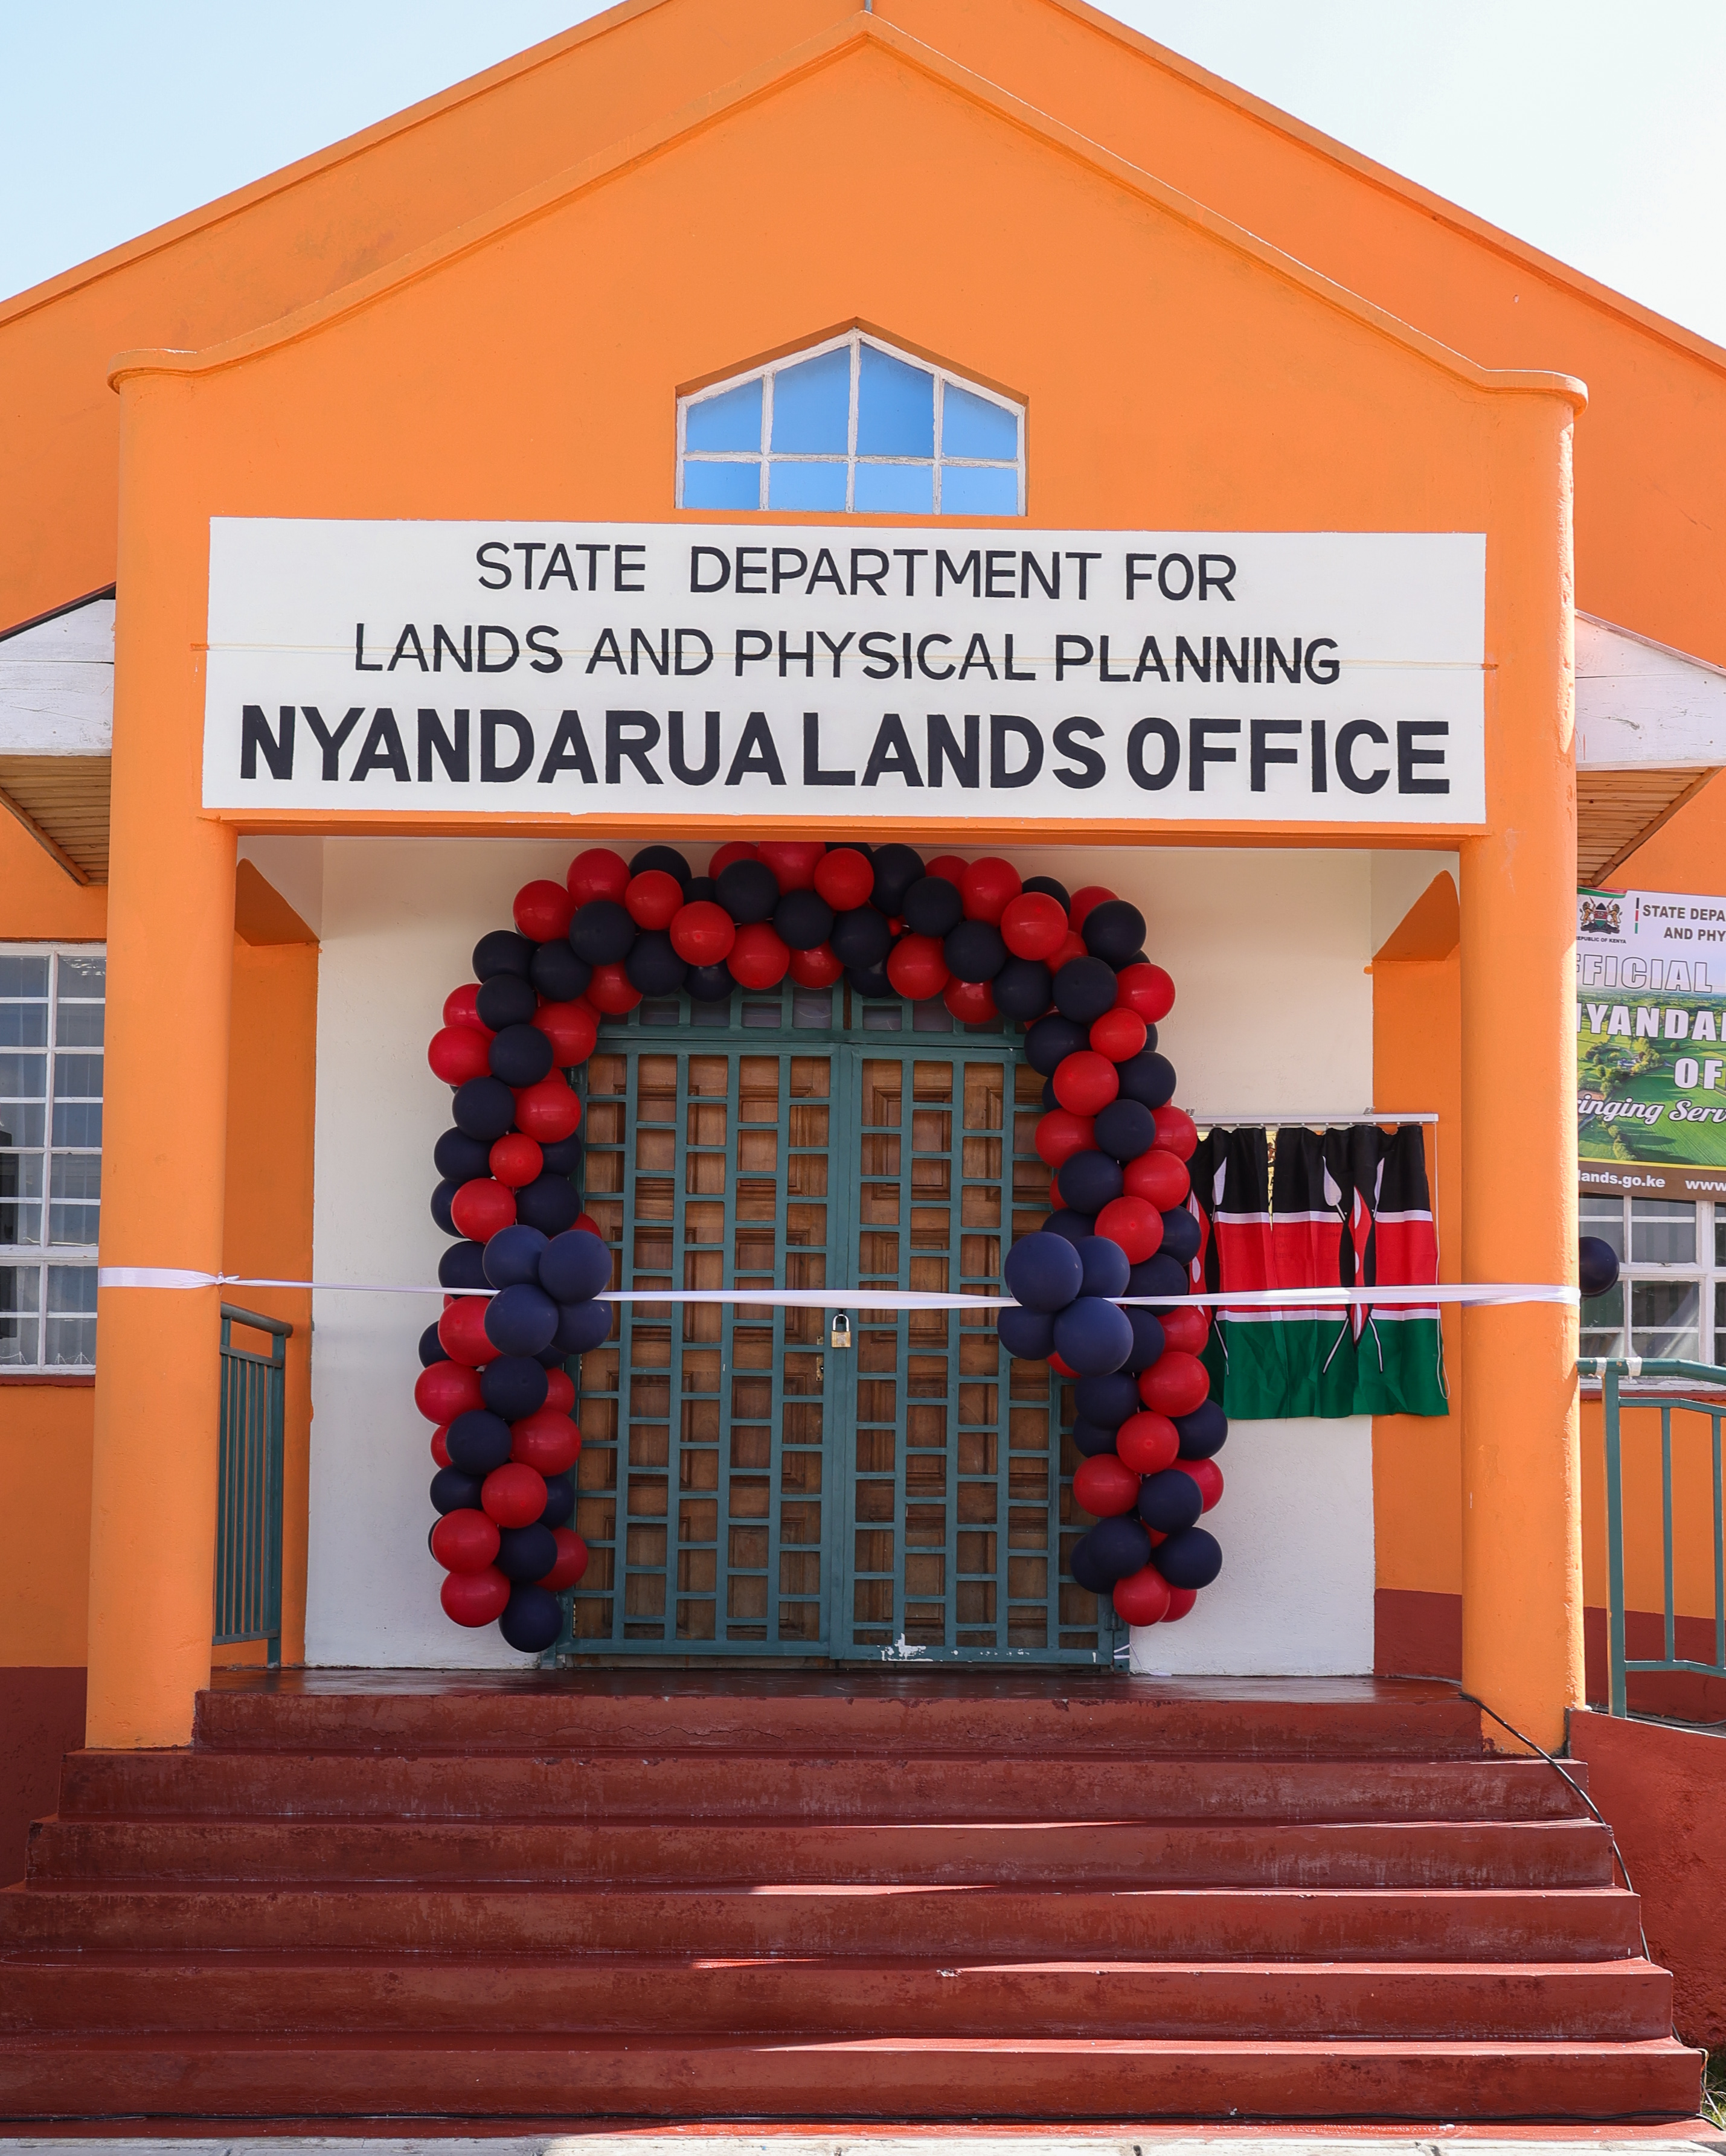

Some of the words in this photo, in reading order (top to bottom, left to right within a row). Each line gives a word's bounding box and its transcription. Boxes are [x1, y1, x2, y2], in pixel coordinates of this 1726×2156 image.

[476, 542, 646, 592] STATE
[690, 546, 1102, 600] DEPARTMENT
[1126, 553, 1236, 601] FOR
[355, 623, 563, 674] LANDS
[585, 628, 714, 676] AND
[735, 629, 1036, 681] PHYSICAL
[1056, 635, 1340, 685] PLANNING
[240, 705, 787, 786] NYANDARUA
[803, 712, 1106, 789] LANDS
[1127, 717, 1450, 795] OFFICE
[1642, 904, 1686, 920] STATE
[1690, 907, 1726, 922] DEPA
[1663, 927, 1693, 940] AND
[1576, 953, 1713, 993] FICIAL
[1577, 1002, 1726, 1043] YANDA
[1674, 1057, 1726, 1090] OF
